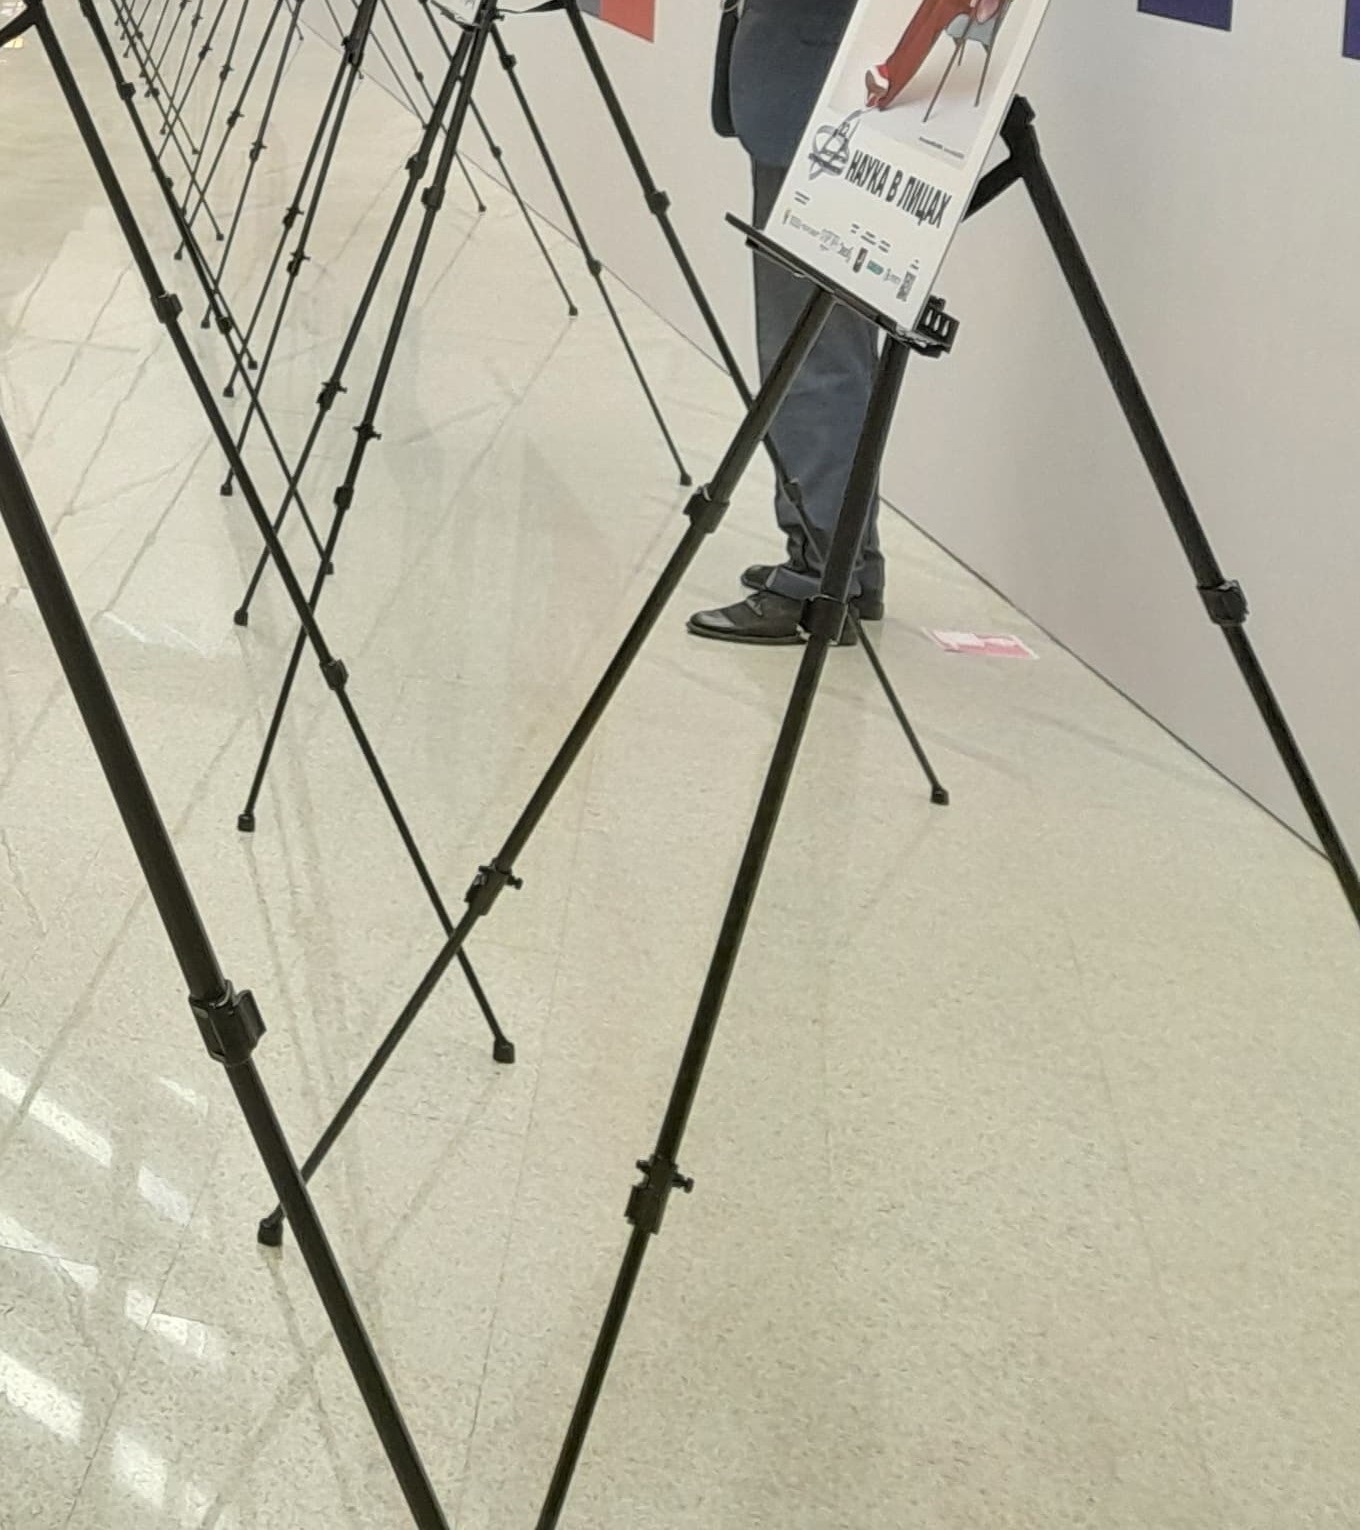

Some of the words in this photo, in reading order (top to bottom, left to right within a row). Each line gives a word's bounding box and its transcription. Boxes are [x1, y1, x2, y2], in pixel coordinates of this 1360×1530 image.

[844, 149, 892, 198] НАУКА
[885, 169, 904, 203] В
[896, 175, 953, 229] ЛИЦАХ
